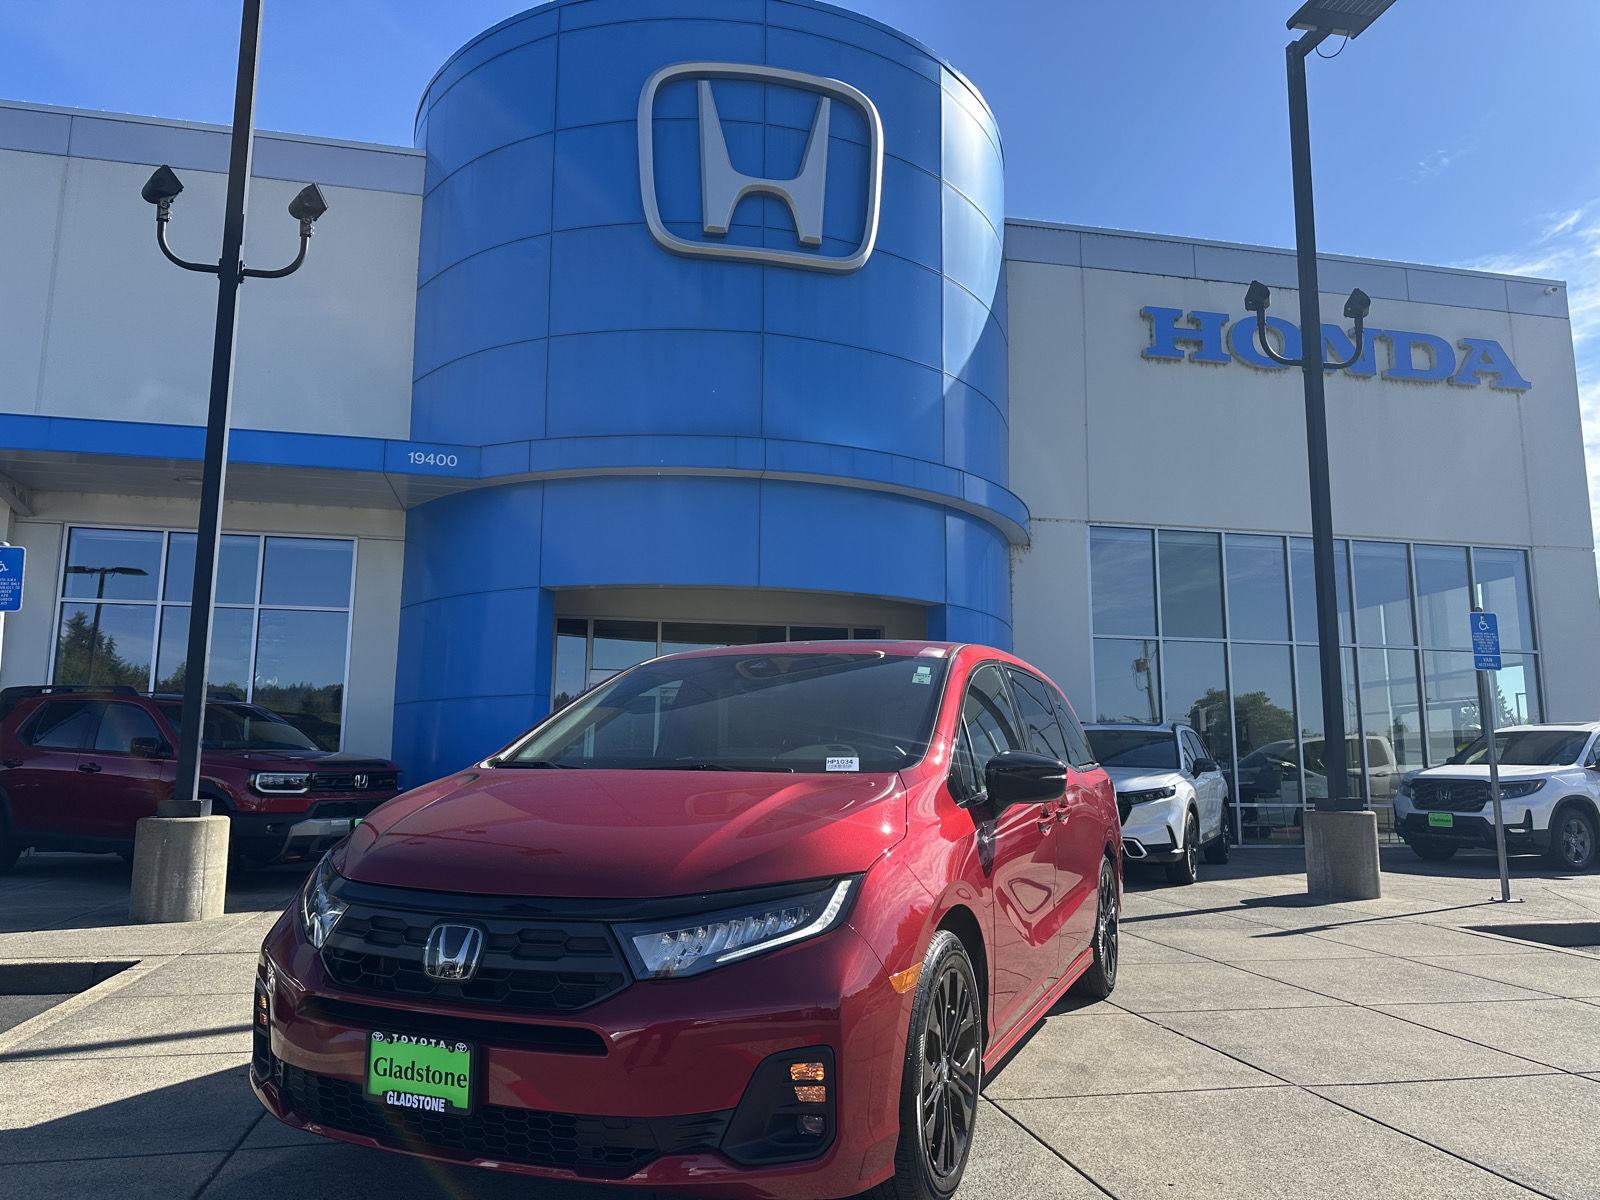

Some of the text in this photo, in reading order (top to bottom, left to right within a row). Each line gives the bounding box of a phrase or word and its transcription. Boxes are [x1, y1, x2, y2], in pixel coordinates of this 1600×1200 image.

[1140, 305, 1532, 392] HONDA
[407, 451, 458, 467] 19400
[391, 1033, 447, 1049] TOYOTA
[373, 1056, 468, 1089] Gladstone
[386, 1090, 446, 1113] GLADSTONE
